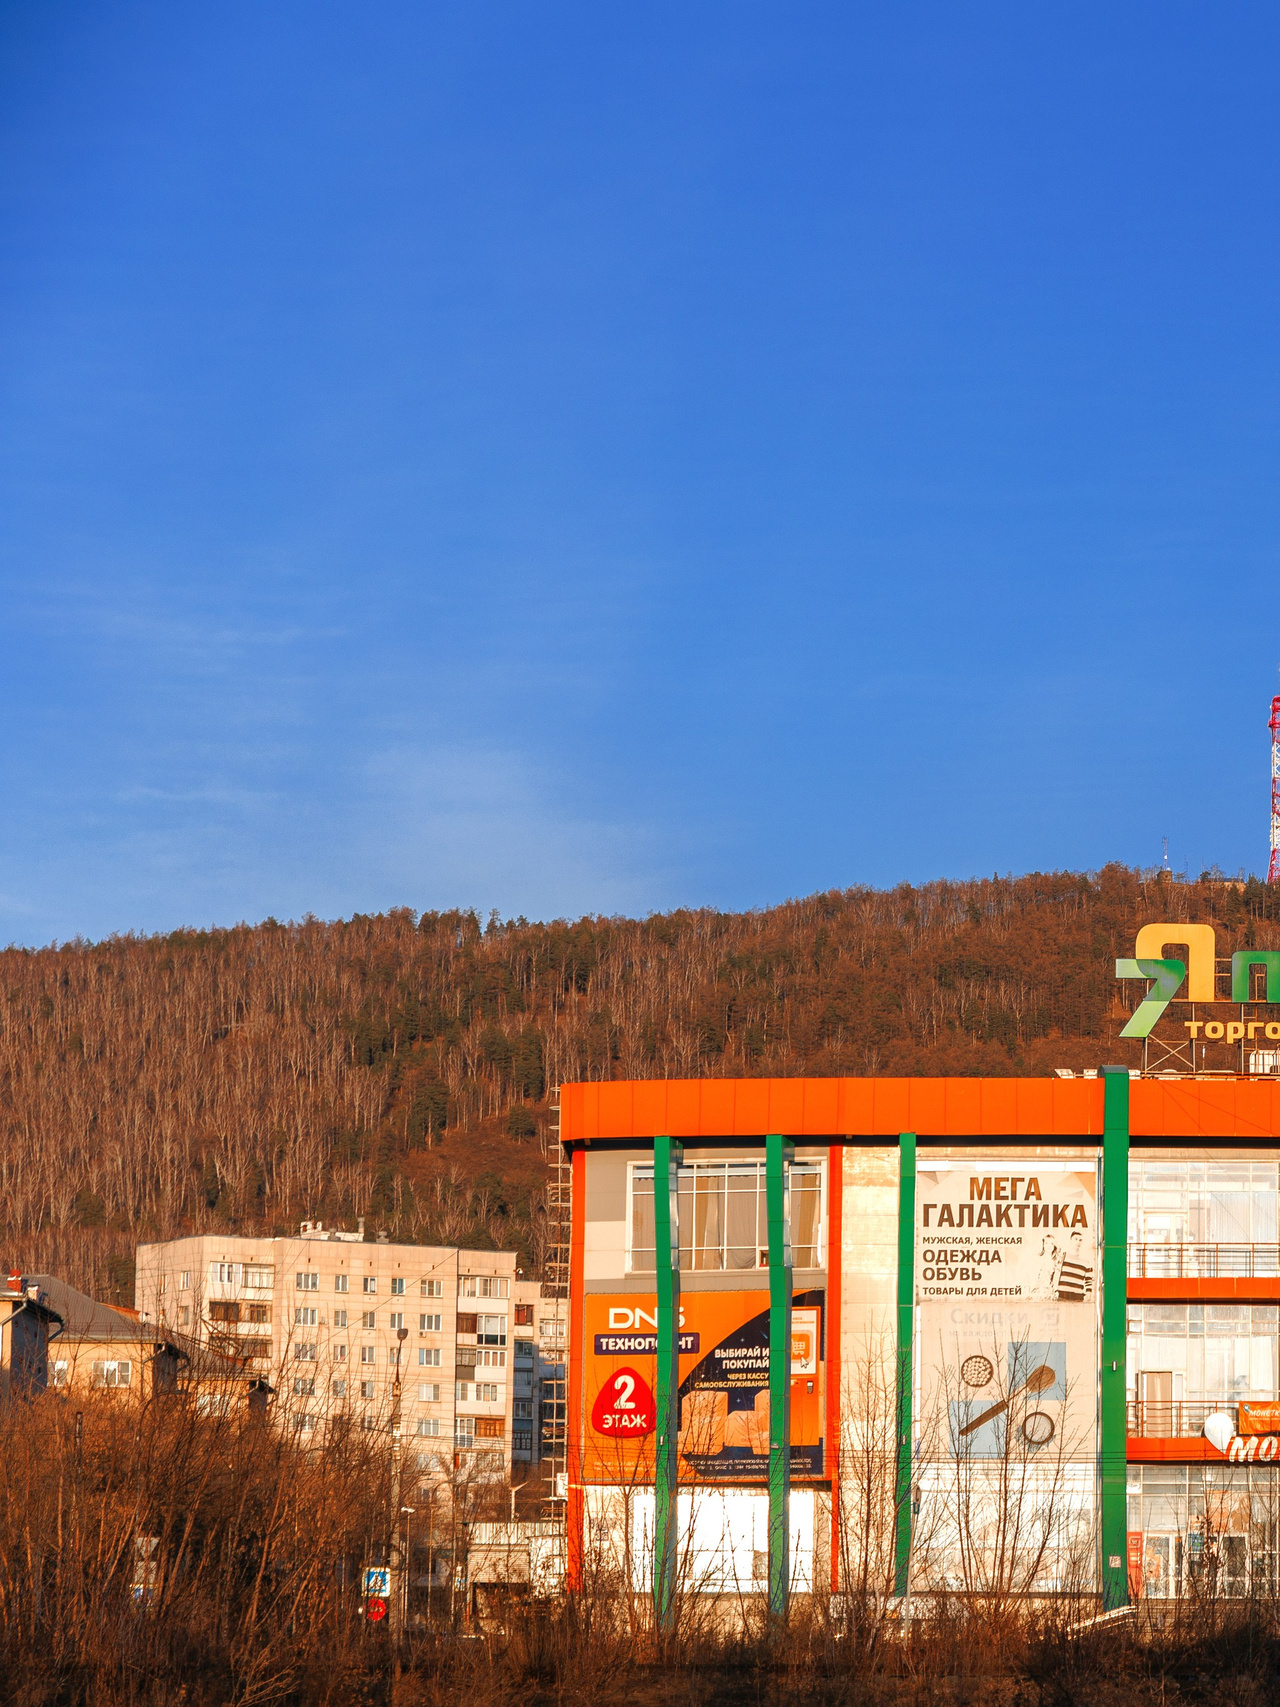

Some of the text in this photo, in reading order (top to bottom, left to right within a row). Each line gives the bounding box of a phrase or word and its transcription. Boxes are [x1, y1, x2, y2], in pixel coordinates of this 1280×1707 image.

[969, 1176, 1043, 1201] МЕГА
[922, 1203, 1089, 1229] ГАЛАКТИКА
[922, 1236, 1023, 1246] МУЖСКАЯ, ЖЕНСКАЯ
[922, 1249, 1002, 1266] ОДЕЖДА
[922, 1267, 983, 1281] ОБУВЬ
[922, 1285, 1022, 1297] ТОВАРЫ ДЛЯ ДЕТЕЙ
[608, 1306, 686, 1329] DN
[714, 1345, 770, 1359] ВЫБИРАЙ И
[722, 1357, 770, 1370] ПОКУПАЙ
[747, 1372, 769, 1380] КАССУ
[613, 1375, 637, 1410] 2
[602, 1414, 647, 1429] ЭТАЖ
